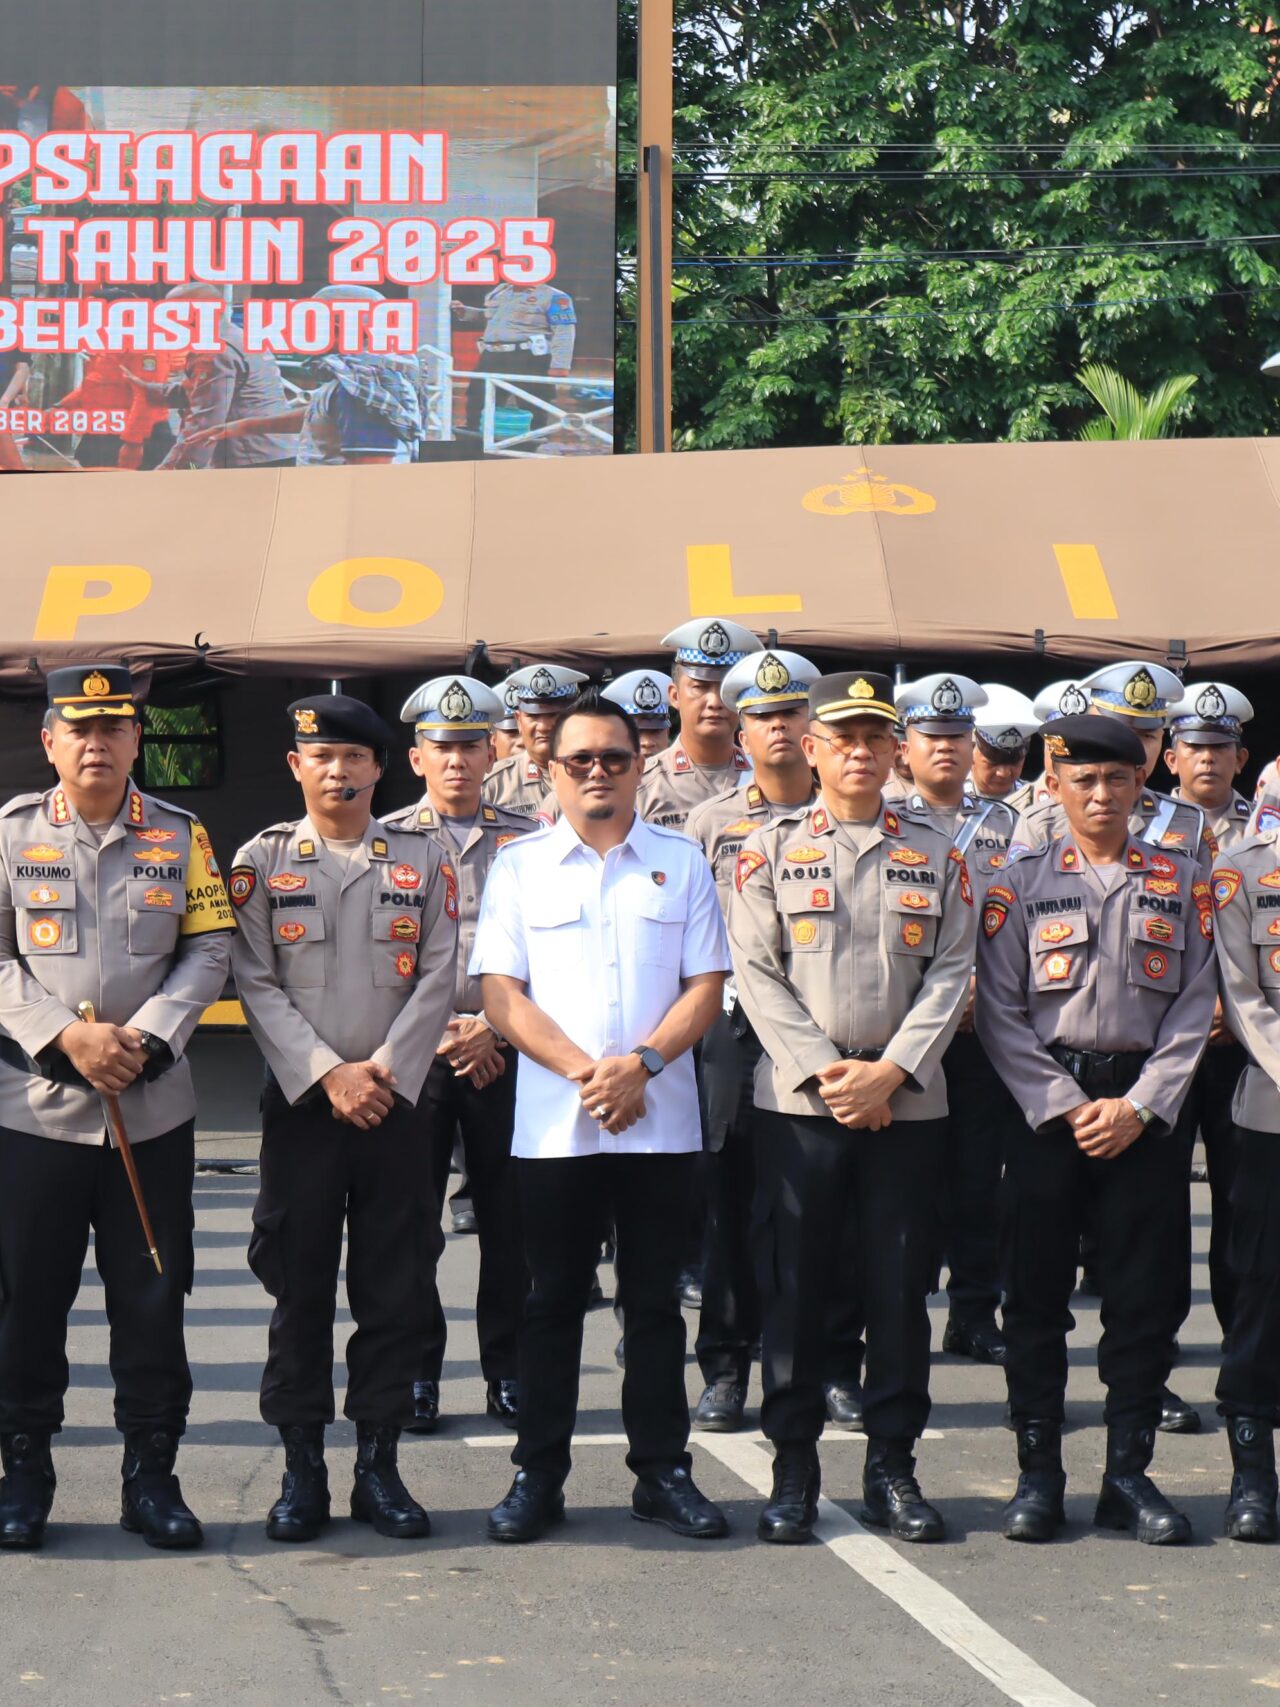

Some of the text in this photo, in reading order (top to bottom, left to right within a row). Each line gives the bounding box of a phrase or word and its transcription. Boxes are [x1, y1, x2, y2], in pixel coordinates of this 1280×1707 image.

[24, 217, 304, 284] TAHUN
[328, 217, 557, 286] 2025
[243, 298, 419, 353] KOTA
[53, 409, 127, 433] 2025
[721, 842, 742, 857] ISWA
[975, 838, 1012, 850] POLR
[16, 865, 71, 880] KUSUMO
[133, 865, 183, 881] POLRI
[780, 866, 832, 881] AGUS
[886, 868, 936, 885] POLRI
[185, 884, 225, 902] KAOPS
[186, 902, 206, 914] OPS
[1138, 896, 1183, 915] POLRI
[217, 909, 236, 920] 202
